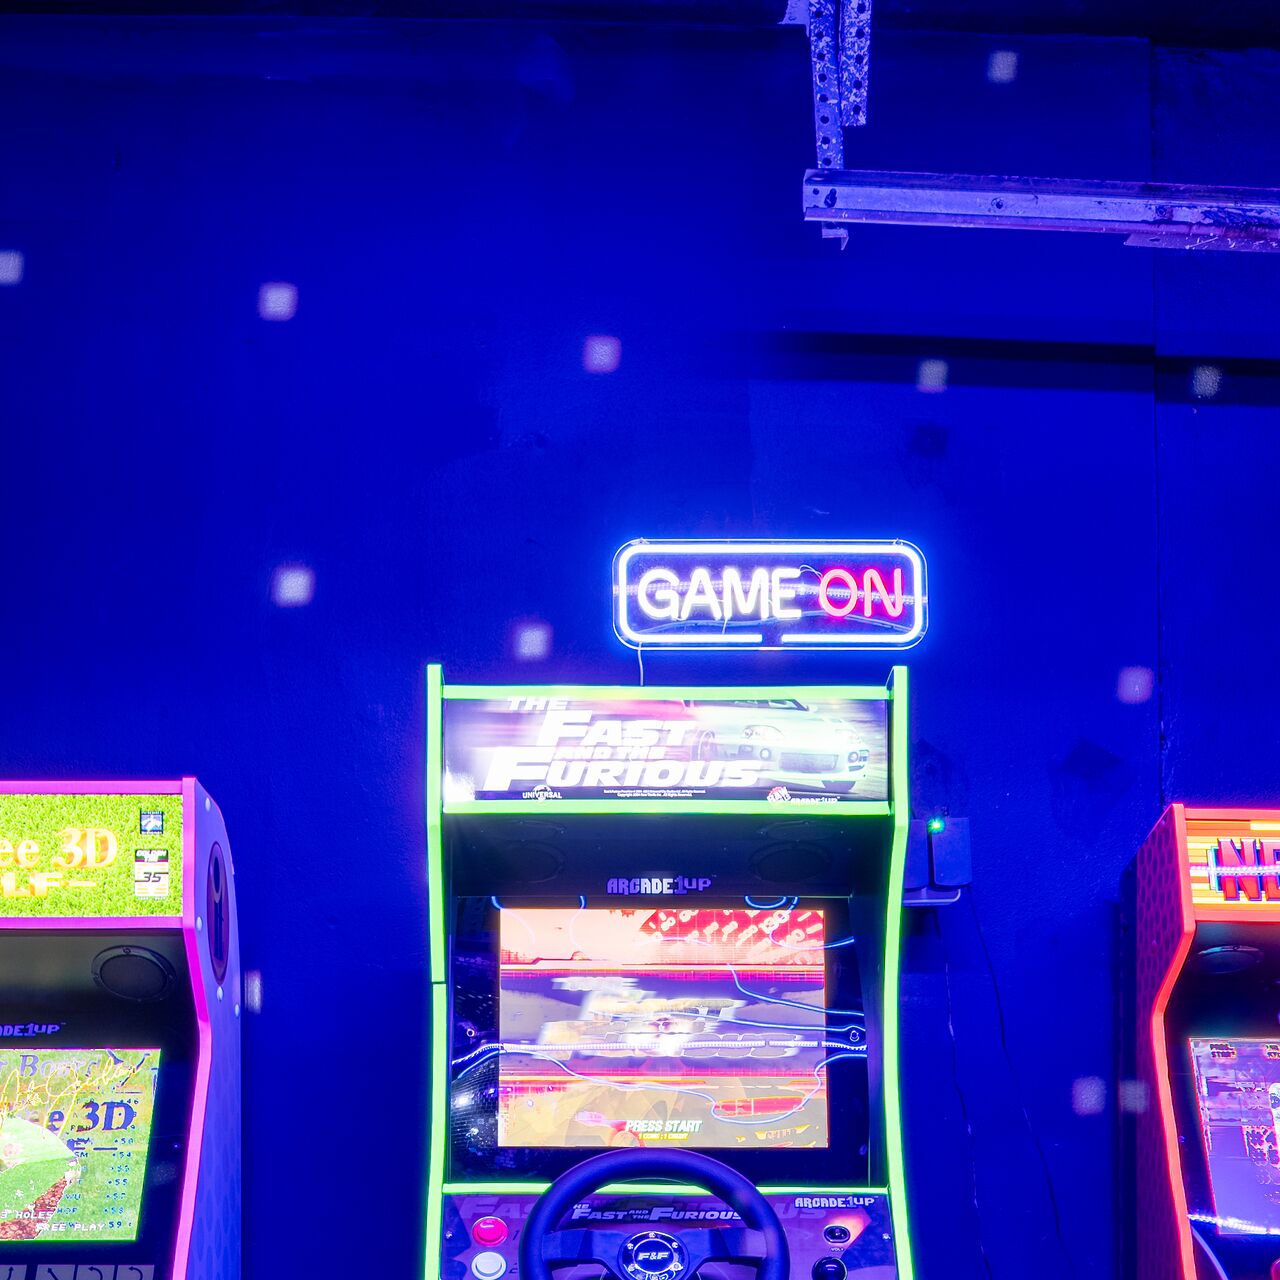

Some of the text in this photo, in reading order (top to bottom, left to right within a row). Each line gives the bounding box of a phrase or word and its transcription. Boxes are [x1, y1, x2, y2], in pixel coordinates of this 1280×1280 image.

[637, 566, 905, 620] GAME ON
[507, 696, 569, 711] THE
[536, 709, 698, 747] FAST
[482, 746, 765, 792] FURIOUS
[522, 790, 563, 799] UNIVERSAL
[52, 828, 118, 869] 3D
[607, 876, 712, 895] ARCADE1UP
[82, 1100, 135, 1132] 3D
[626, 1119, 703, 1132] PRESS START
[795, 1196, 875, 1209] ARCADE1UP
[15, 1211, 54, 1219] HOLES
[572, 1208, 628, 1220] FAST
[73, 1223, 106, 1231] PLAY
[637, 1252, 670, 1261] F&F
